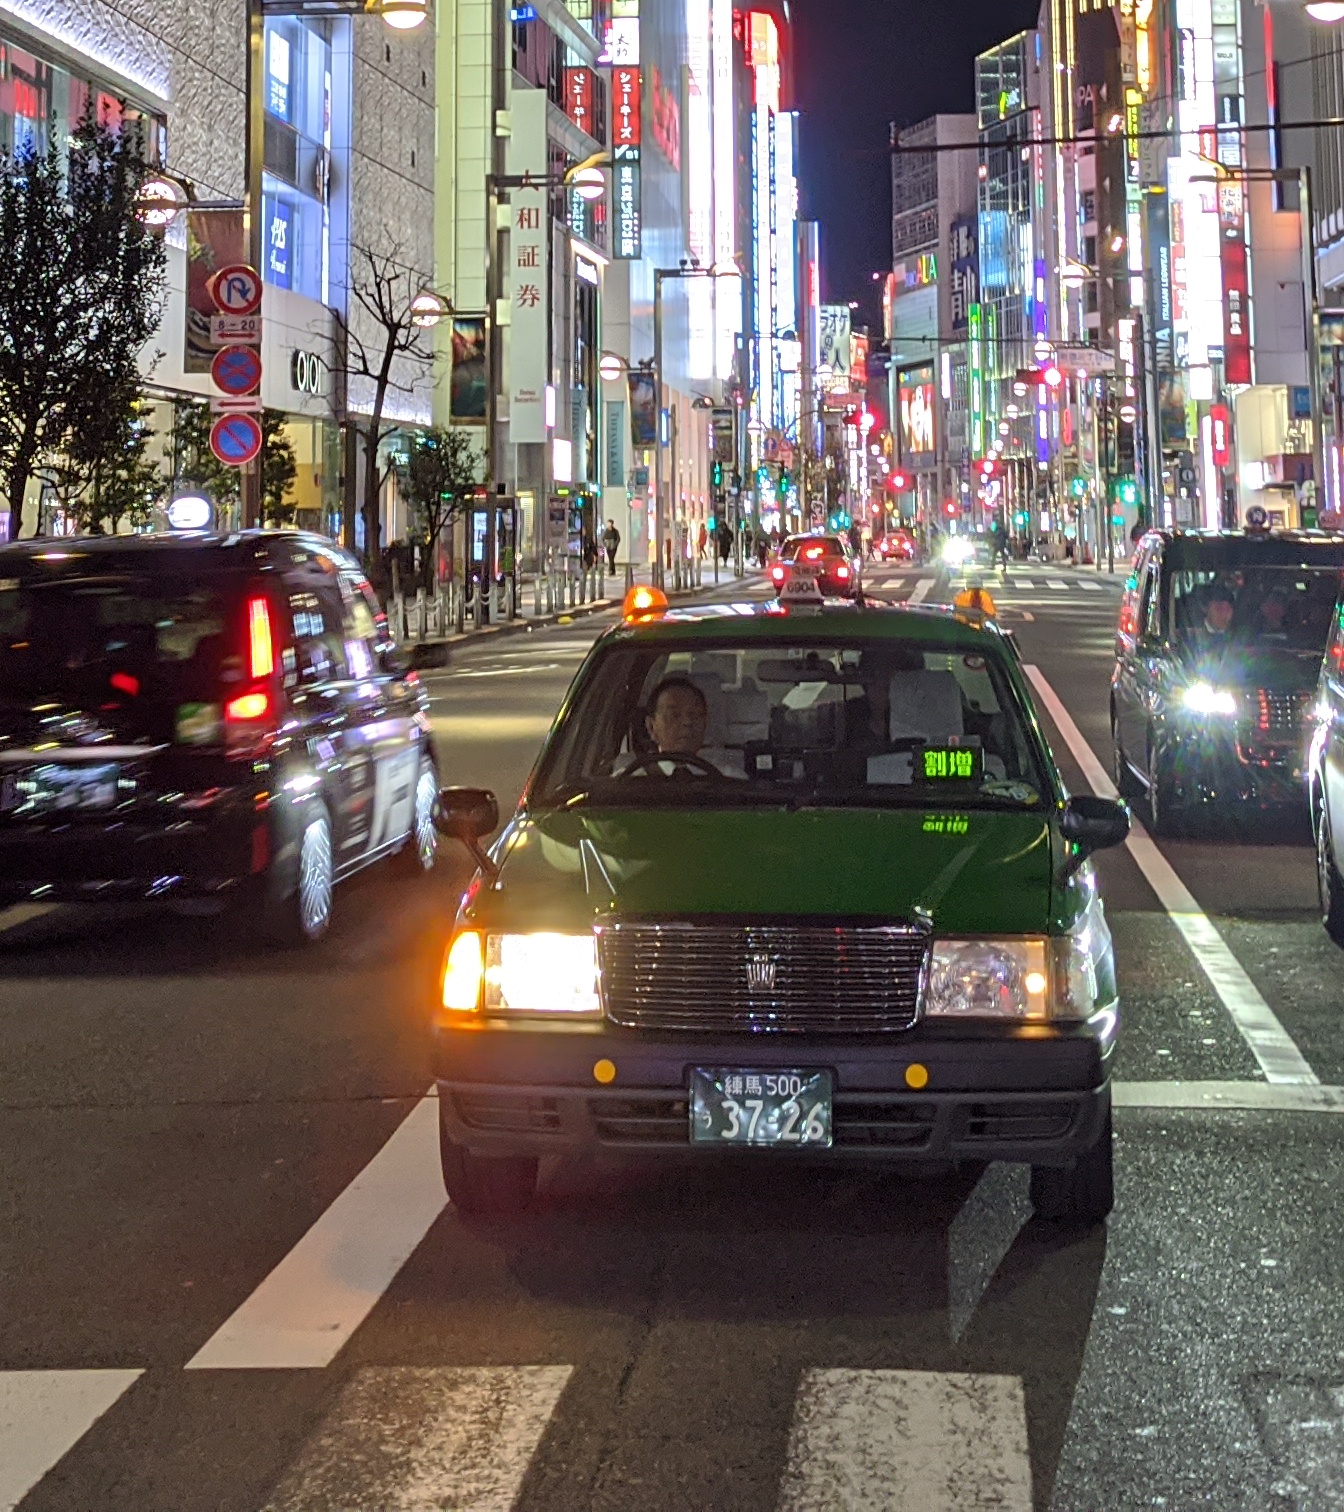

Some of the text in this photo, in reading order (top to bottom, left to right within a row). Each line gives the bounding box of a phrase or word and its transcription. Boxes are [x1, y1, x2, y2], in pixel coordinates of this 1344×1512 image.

[619, 72, 633, 139] シェーキーズ
[515, 169, 541, 309] 大和証券
[924, 750, 973, 777] 割増
[721, 1099, 824, 1142] 37-26
